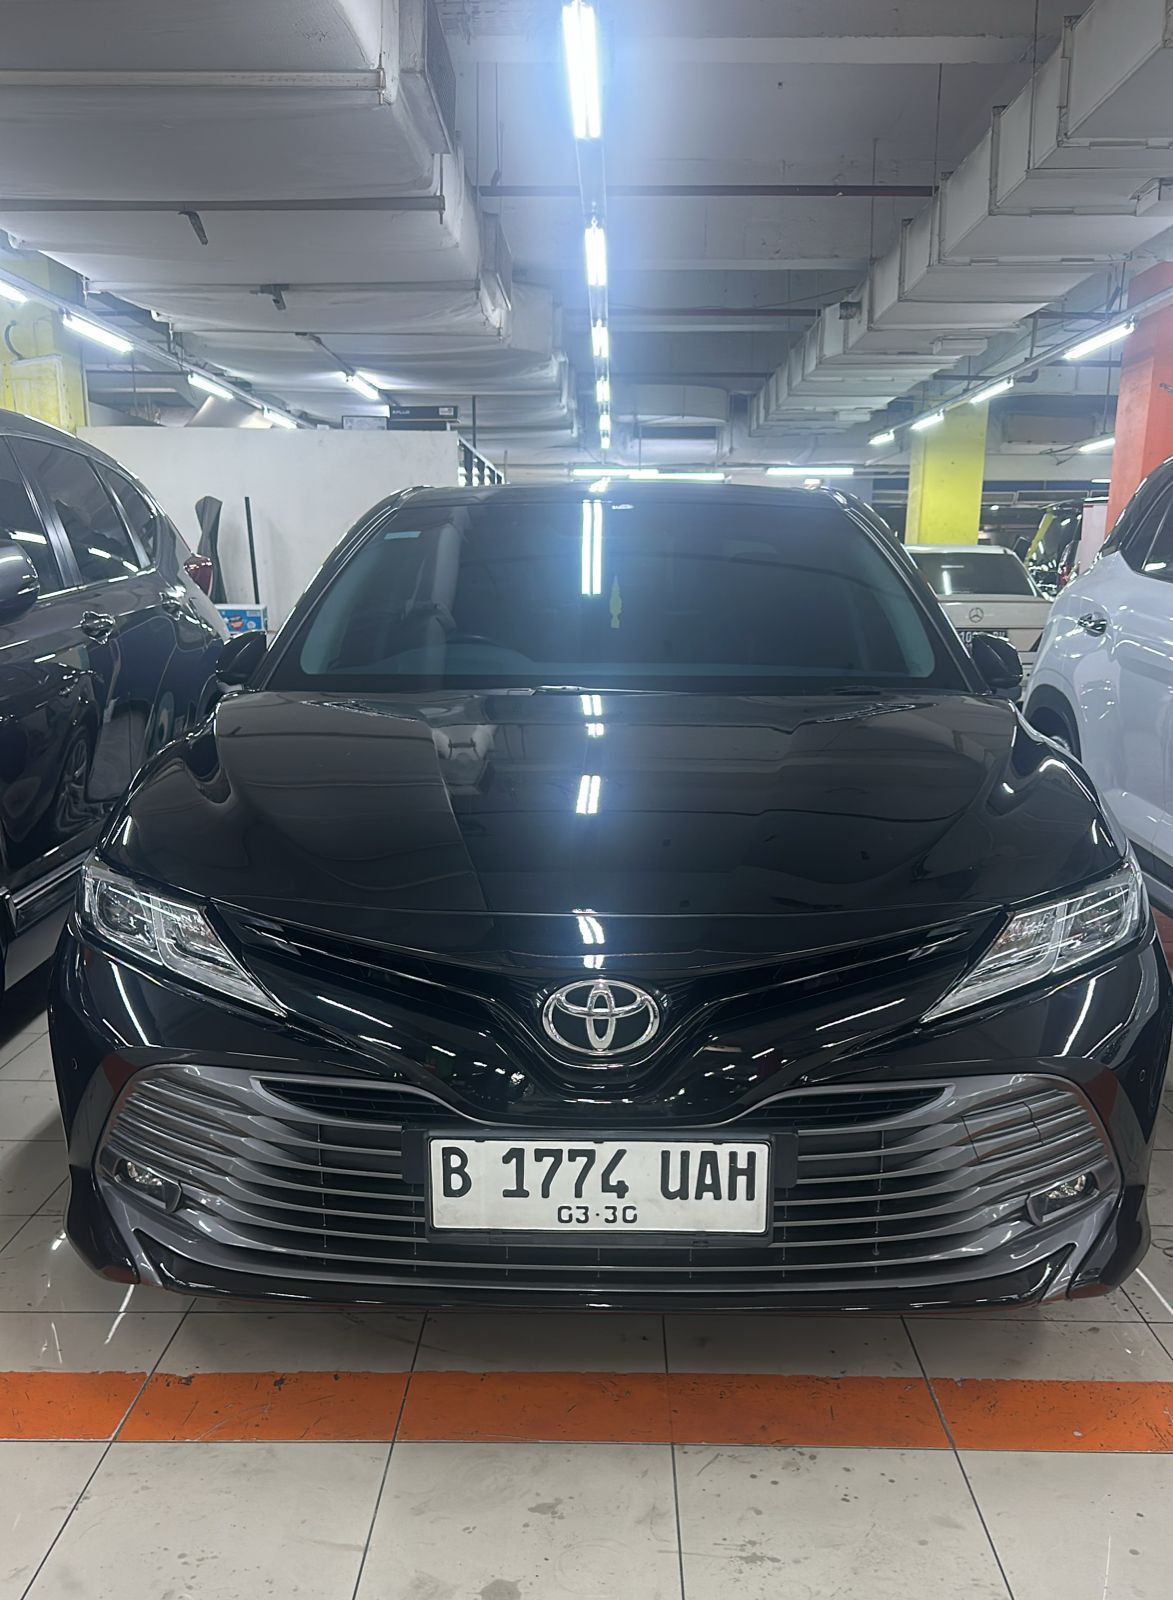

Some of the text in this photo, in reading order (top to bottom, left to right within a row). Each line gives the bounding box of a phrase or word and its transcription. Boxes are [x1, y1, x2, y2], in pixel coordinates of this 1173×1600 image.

[441, 1146, 757, 1202] B 1774 UAH
